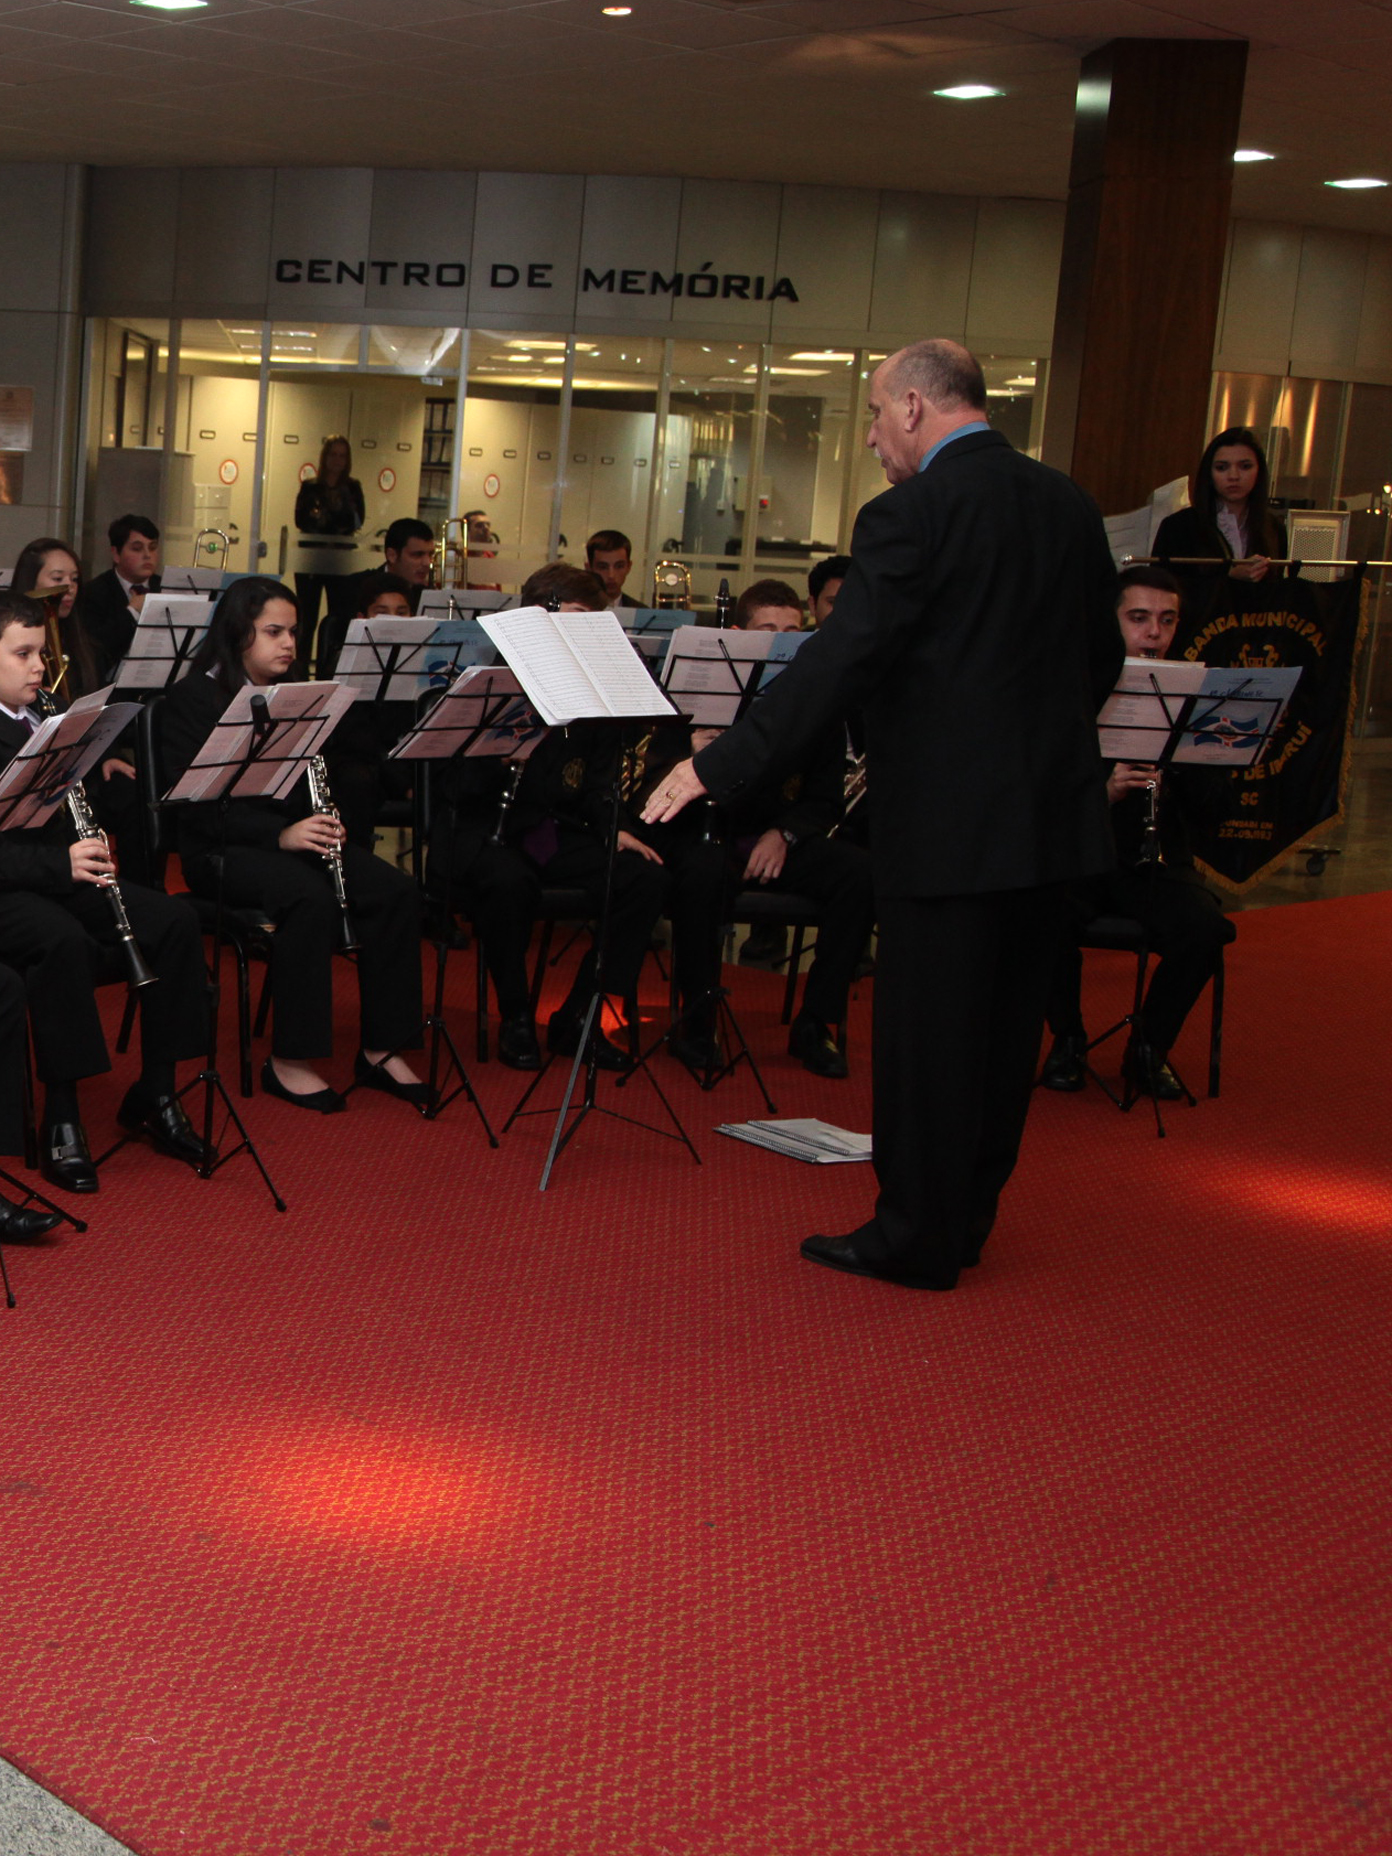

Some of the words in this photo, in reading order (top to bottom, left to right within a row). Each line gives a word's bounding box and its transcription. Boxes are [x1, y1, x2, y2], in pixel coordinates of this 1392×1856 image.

[275, 258, 467, 288] CENTRO
[490, 263, 553, 289] DE
[582, 261, 801, 303] MEMÓRIA
[1183, 612, 1239, 662] BANDA
[1241, 611, 1328, 657] MUNICIPAL
[1240, 792, 1259, 806] SC
